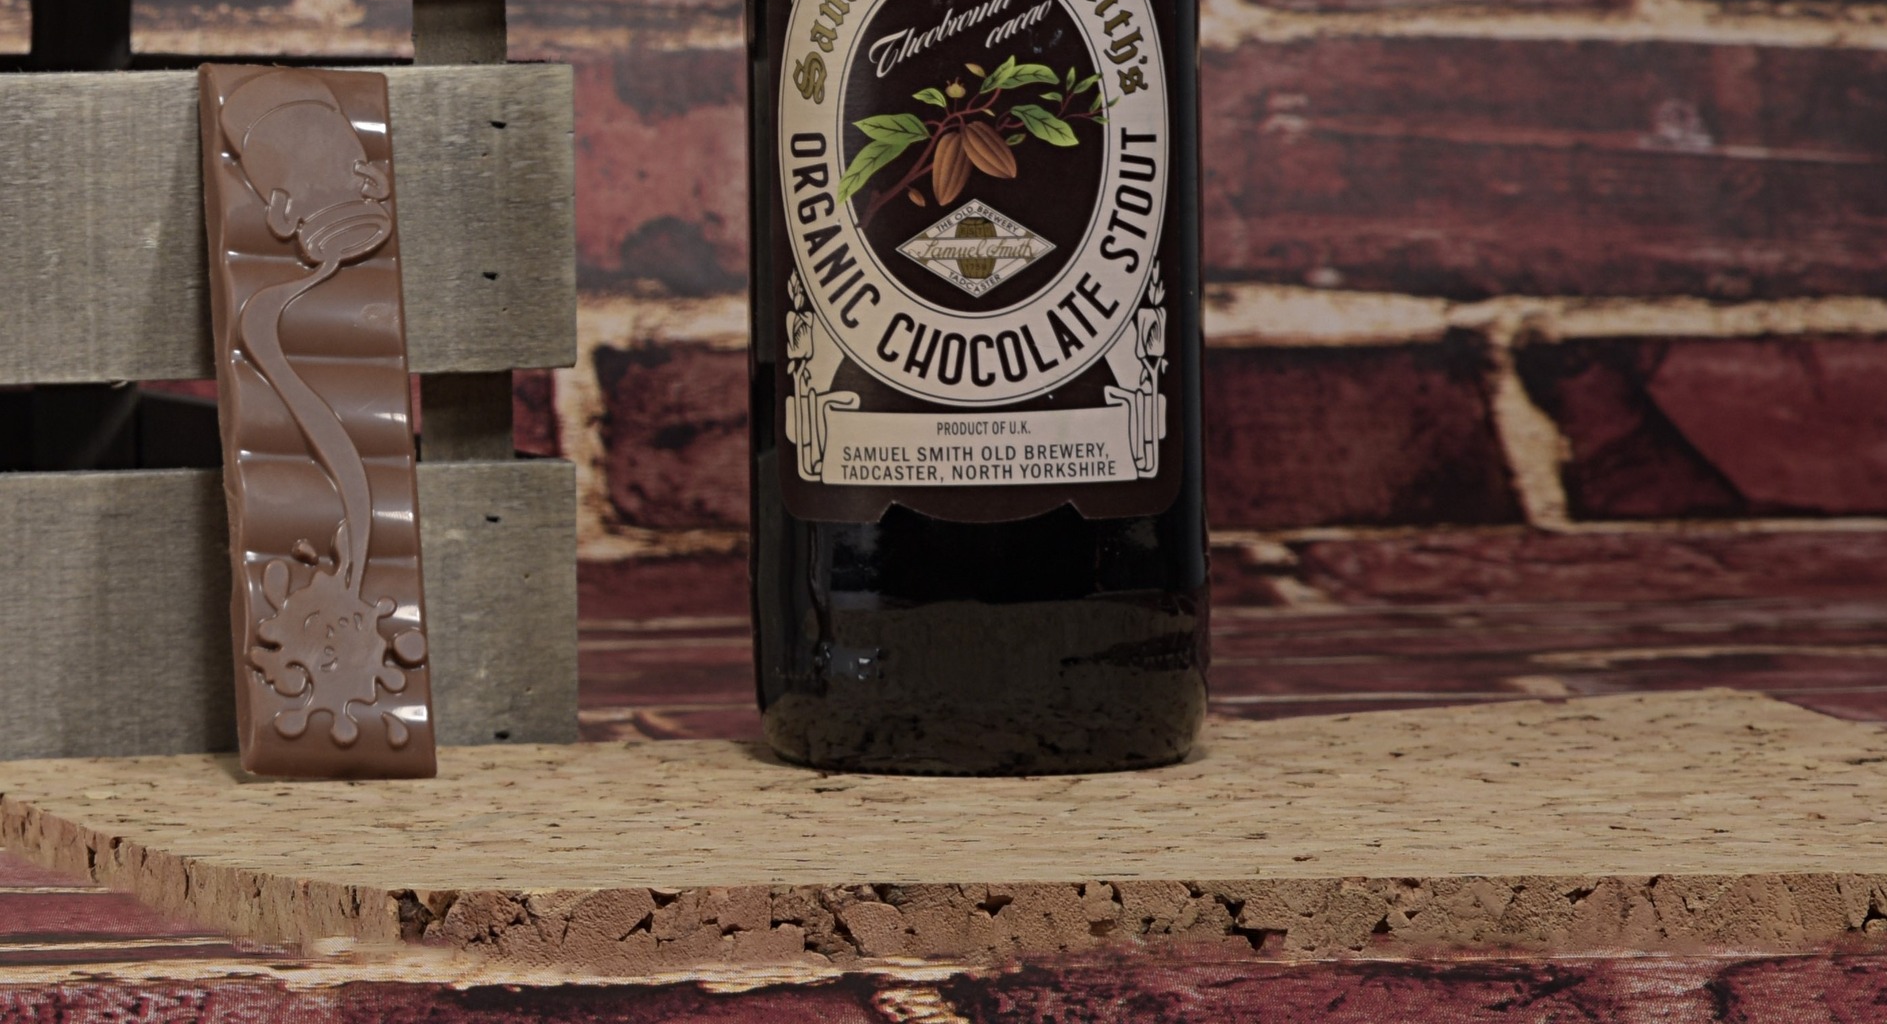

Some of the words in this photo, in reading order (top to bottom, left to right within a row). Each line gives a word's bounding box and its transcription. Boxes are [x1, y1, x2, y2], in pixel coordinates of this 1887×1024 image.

[985, 0, 1052, 49] cacao
[936, 219, 953, 233] THE
[955, 206, 974, 221] OLD
[976, 205, 1019, 233] BREWERY
[790, 132, 881, 329] ORGANIC
[876, 272, 1120, 387] CHOCOLATE
[1101, 127, 1157, 273] STOUT
[909, 239, 987, 258] Samuel
[986, 238, 1036, 258] Smith
[950, 272, 1001, 294] TADCASTER
[937, 421, 988, 436] PRODUCT
[992, 421, 1006, 435] OF
[1009, 420, 1031, 434] U.K.
[843, 446, 910, 462] SAMUEL
[917, 445, 973, 461] SMITH
[981, 445, 1016, 461] OLD
[1024, 443, 1109, 460] BREWERY,
[841, 464, 944, 483] TADCASTER,
[952, 463, 1012, 480] NORTH
[1019, 460, 1116, 479] YORKSHIRE
